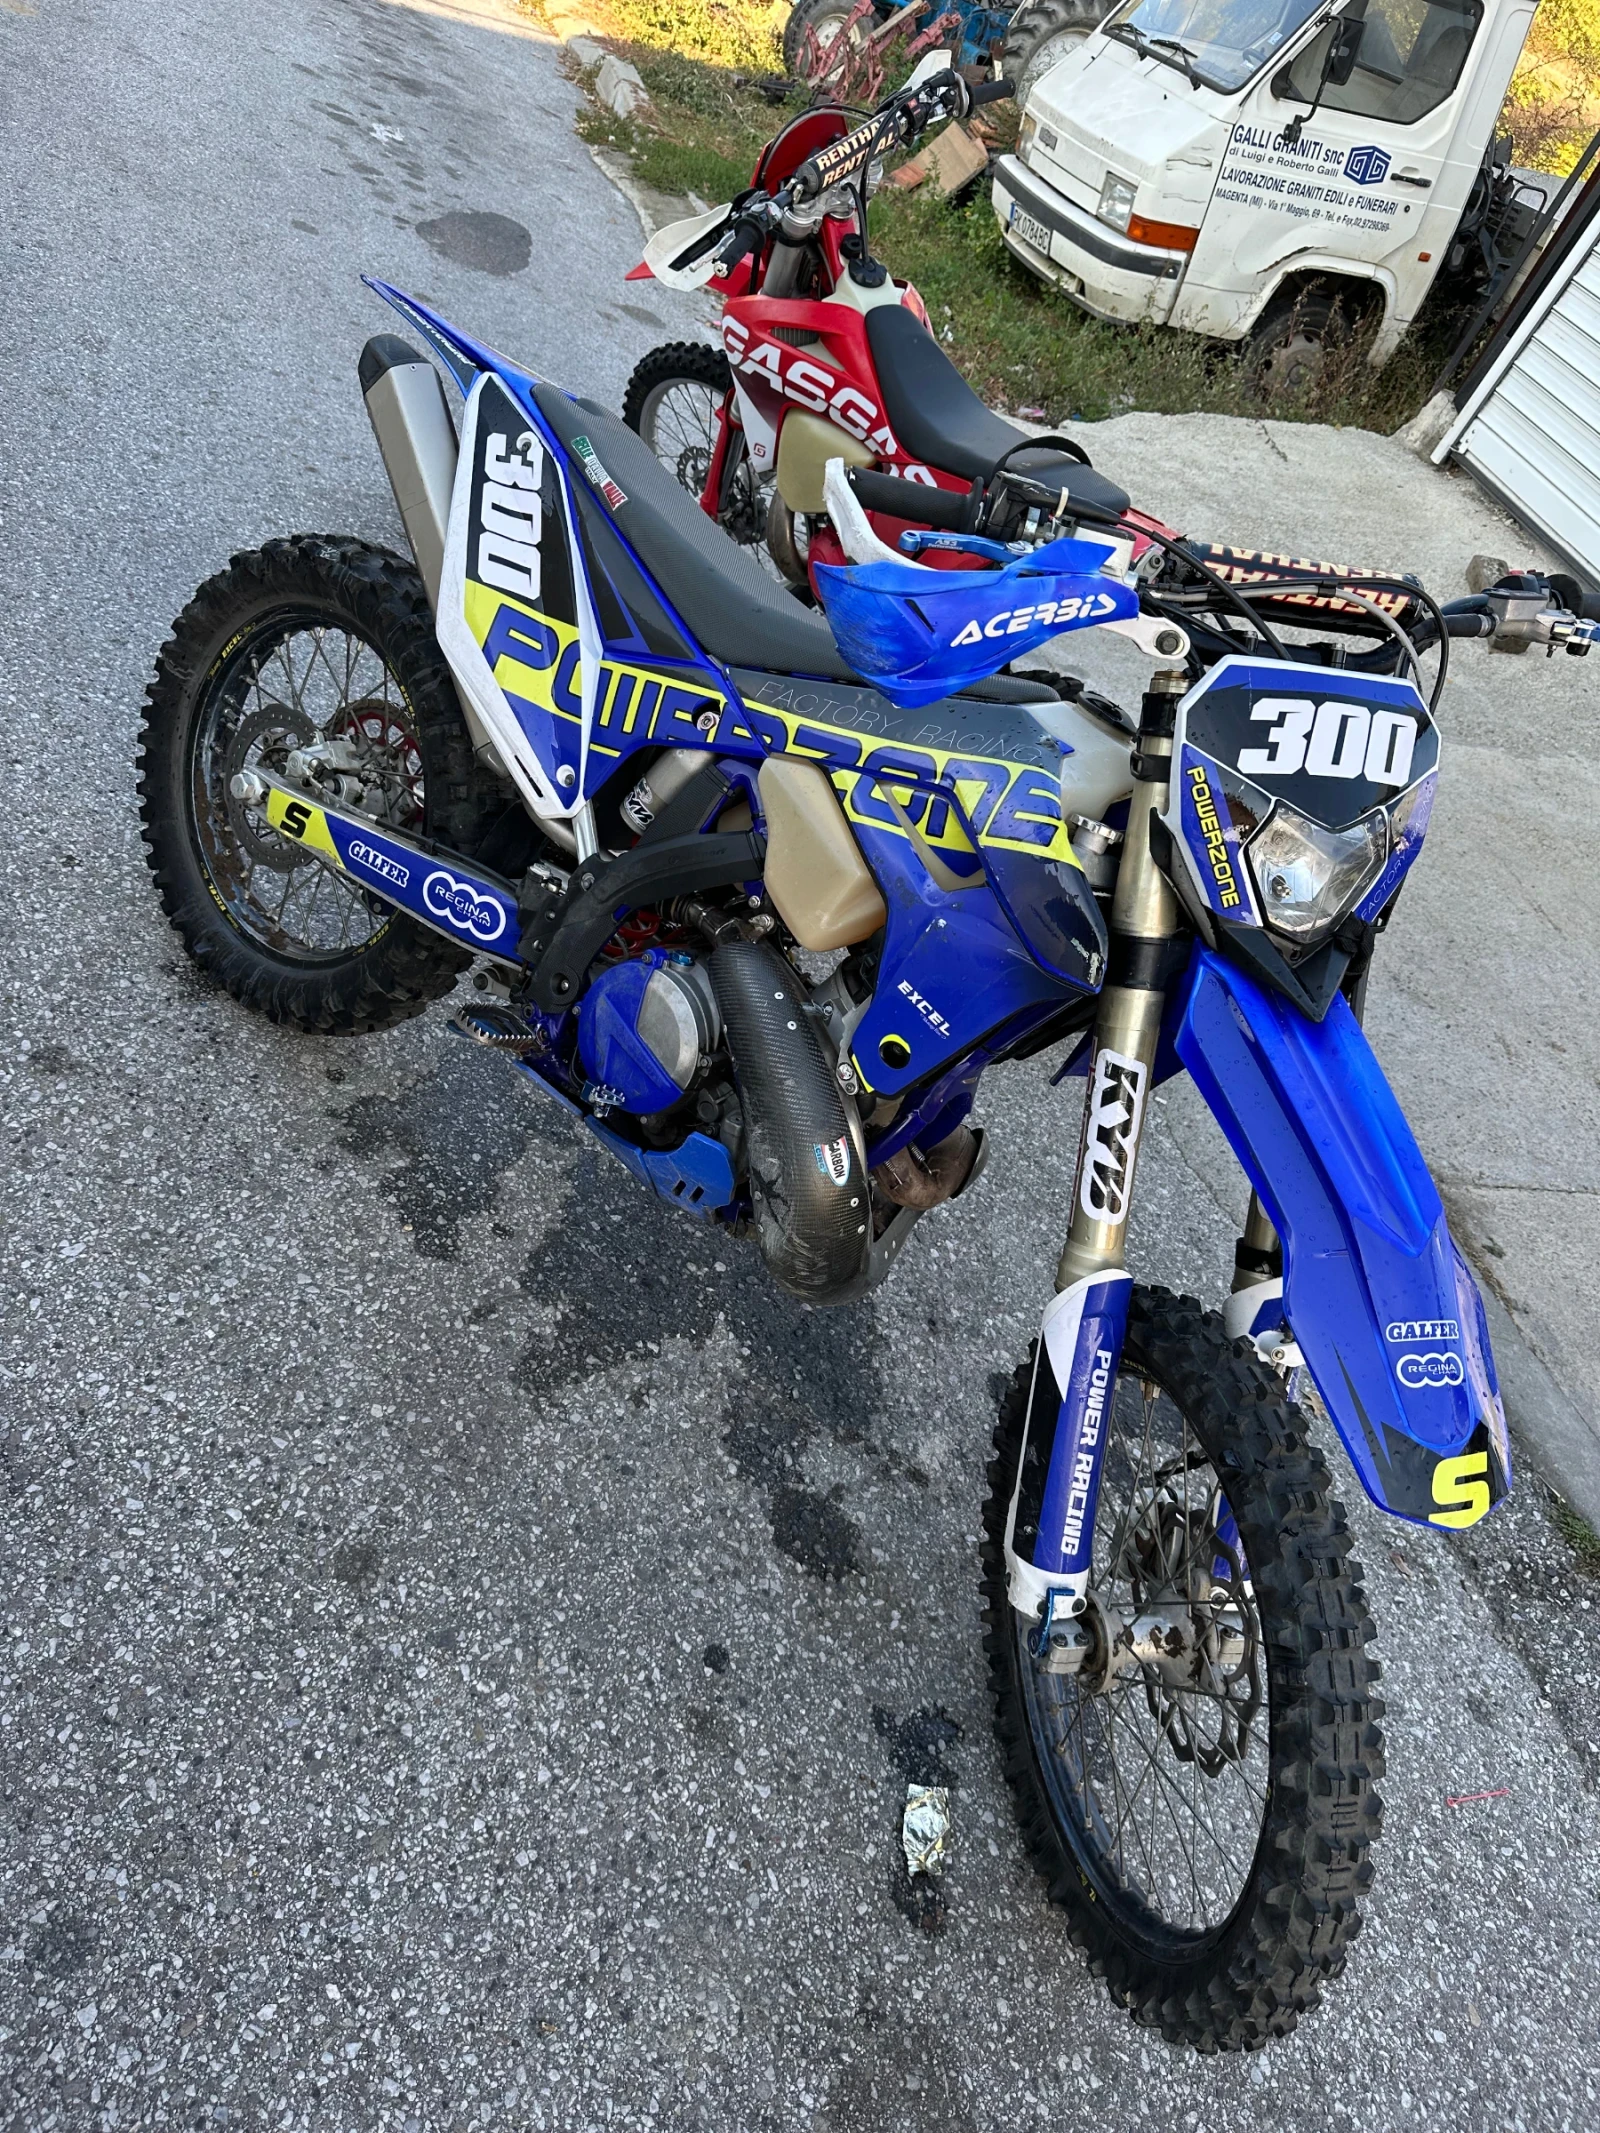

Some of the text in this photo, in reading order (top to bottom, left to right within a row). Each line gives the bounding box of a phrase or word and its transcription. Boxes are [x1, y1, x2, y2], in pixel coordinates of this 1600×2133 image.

[816, 117, 893, 171] RENTHA
[822, 132, 895, 188] RENTAL
[1229, 147, 1239, 156] di
[1241, 149, 1266, 163] Luigi
[1276, 156, 1315, 172] Roberto
[1317, 165, 1340, 177] Galli
[1234, 125, 1345, 165] GALLI GRANITI snc
[1215, 187, 1249, 204] MAGENTA
[1249, 195, 1264, 209] (MI)
[1268, 199, 1278, 210] Via
[1221, 166, 1399, 215] LAVORAZIONE GRANITI EDILI e FUNERARI
[478, 430, 544, 600] 300
[950, 593, 1117, 648] ACERBIS
[755, 681, 1042, 762] FACTORY RACING
[1237, 698, 1418, 787] 300
[280, 801, 312, 839] S
[1186, 766, 1240, 909] POWERZONE
[349, 840, 410, 888] GALFER
[1361, 784, 1434, 921] FACTORY RACING
[435, 885, 490, 922] REGINA
[456, 906, 490, 927] CHAIN
[897, 979, 950, 1036] EXCEL
[814, 1146, 825, 1169] CING
[829, 1140, 846, 1179] CARBON
[1386, 1320, 1460, 1342] GALFER
[1408, 1364, 1457, 1373] REGINA
[1060, 1349, 1112, 1556] POWER RACING
[1428, 1451, 1490, 1529] S
